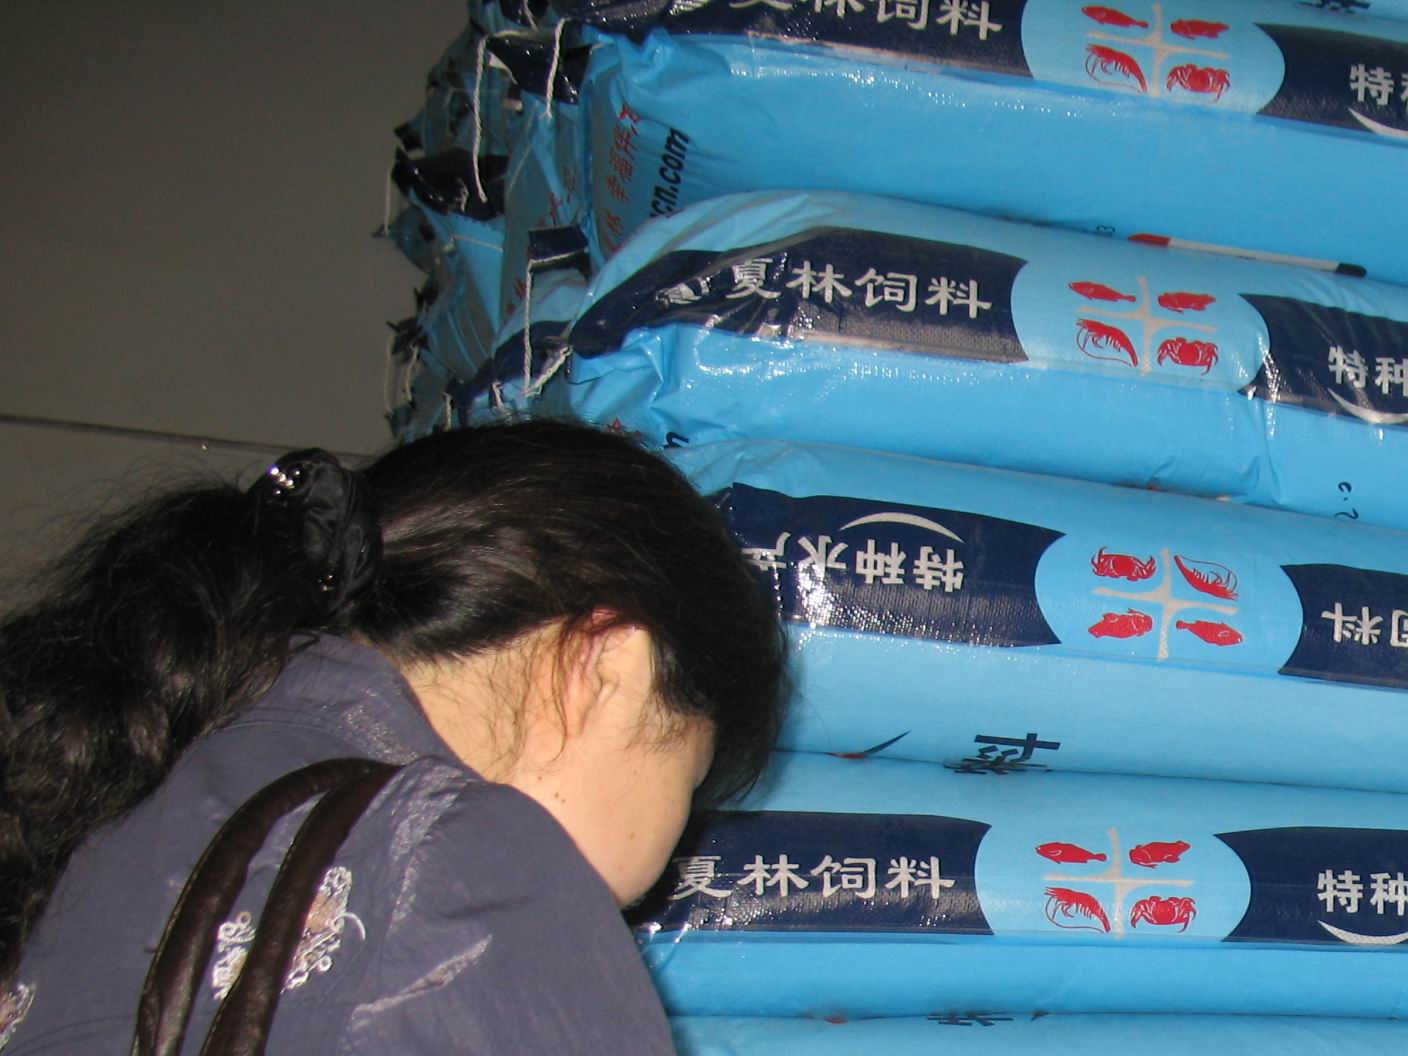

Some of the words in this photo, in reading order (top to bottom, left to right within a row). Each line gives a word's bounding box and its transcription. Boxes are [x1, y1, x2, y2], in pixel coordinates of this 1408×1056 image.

[726, 257, 992, 318] 夏林饲料
[672, 855, 956, 900] 夏林饲料
